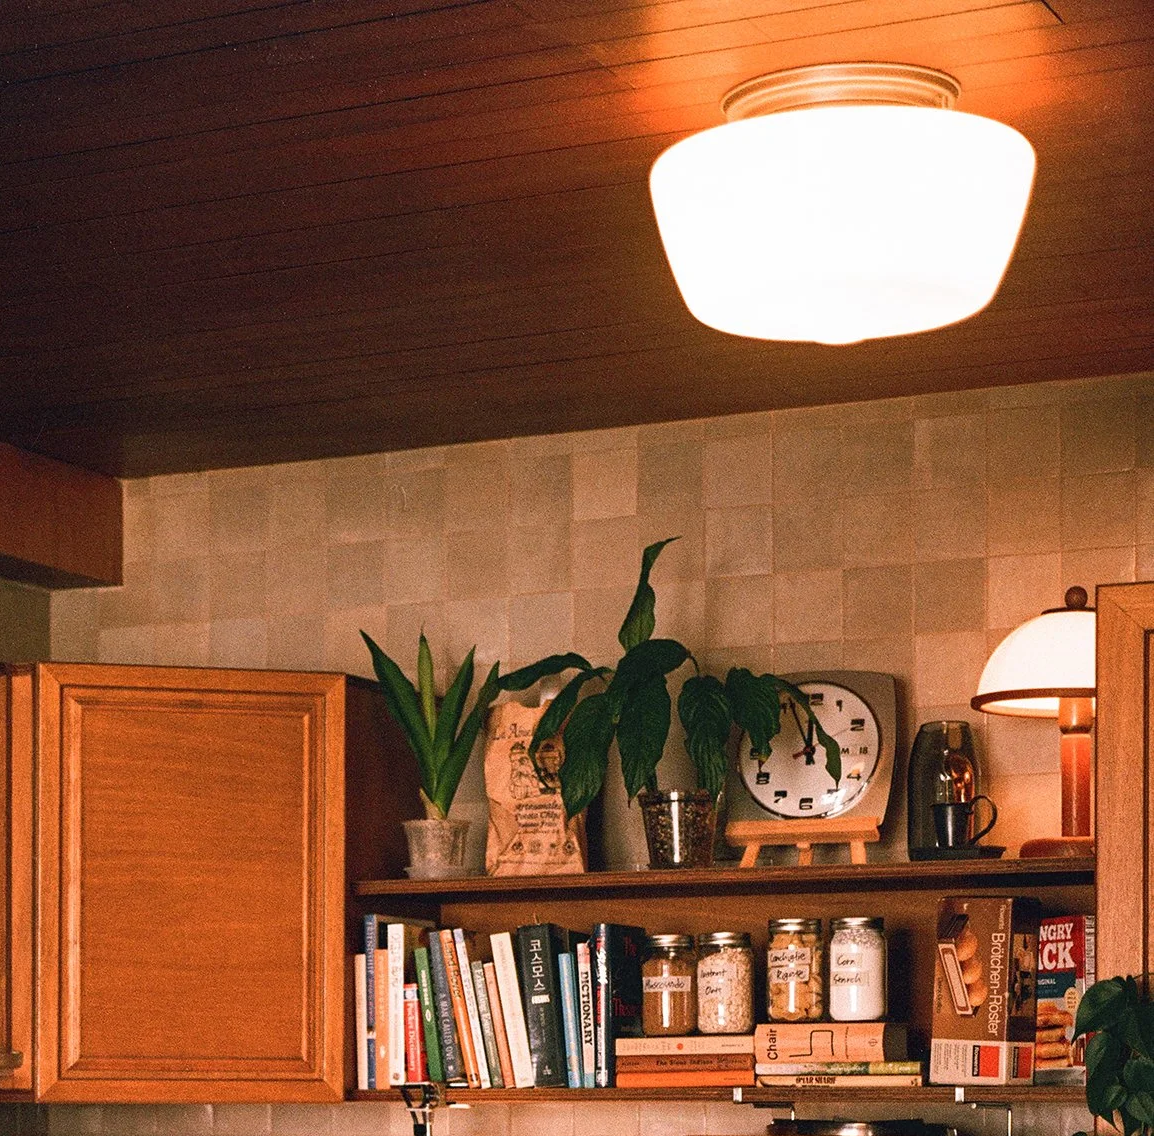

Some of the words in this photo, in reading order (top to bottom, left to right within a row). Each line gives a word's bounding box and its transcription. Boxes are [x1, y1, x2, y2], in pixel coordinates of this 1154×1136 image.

[850, 719, 865, 732] 2
[799, 797, 813, 811] 6
[530, 938, 546, 992] 코스모스
[836, 954, 855, 966] Corn
[988, 932, 1006, 1036] Brötchen-Röster
[407, 1002, 415, 1029] Pocket
[580, 971, 594, 1046] DICTIONARY
[442, 1018, 453, 1044] CALLED
[767, 1028, 778, 1060] Chair
[408, 1030, 417, 1071] Dictionary
